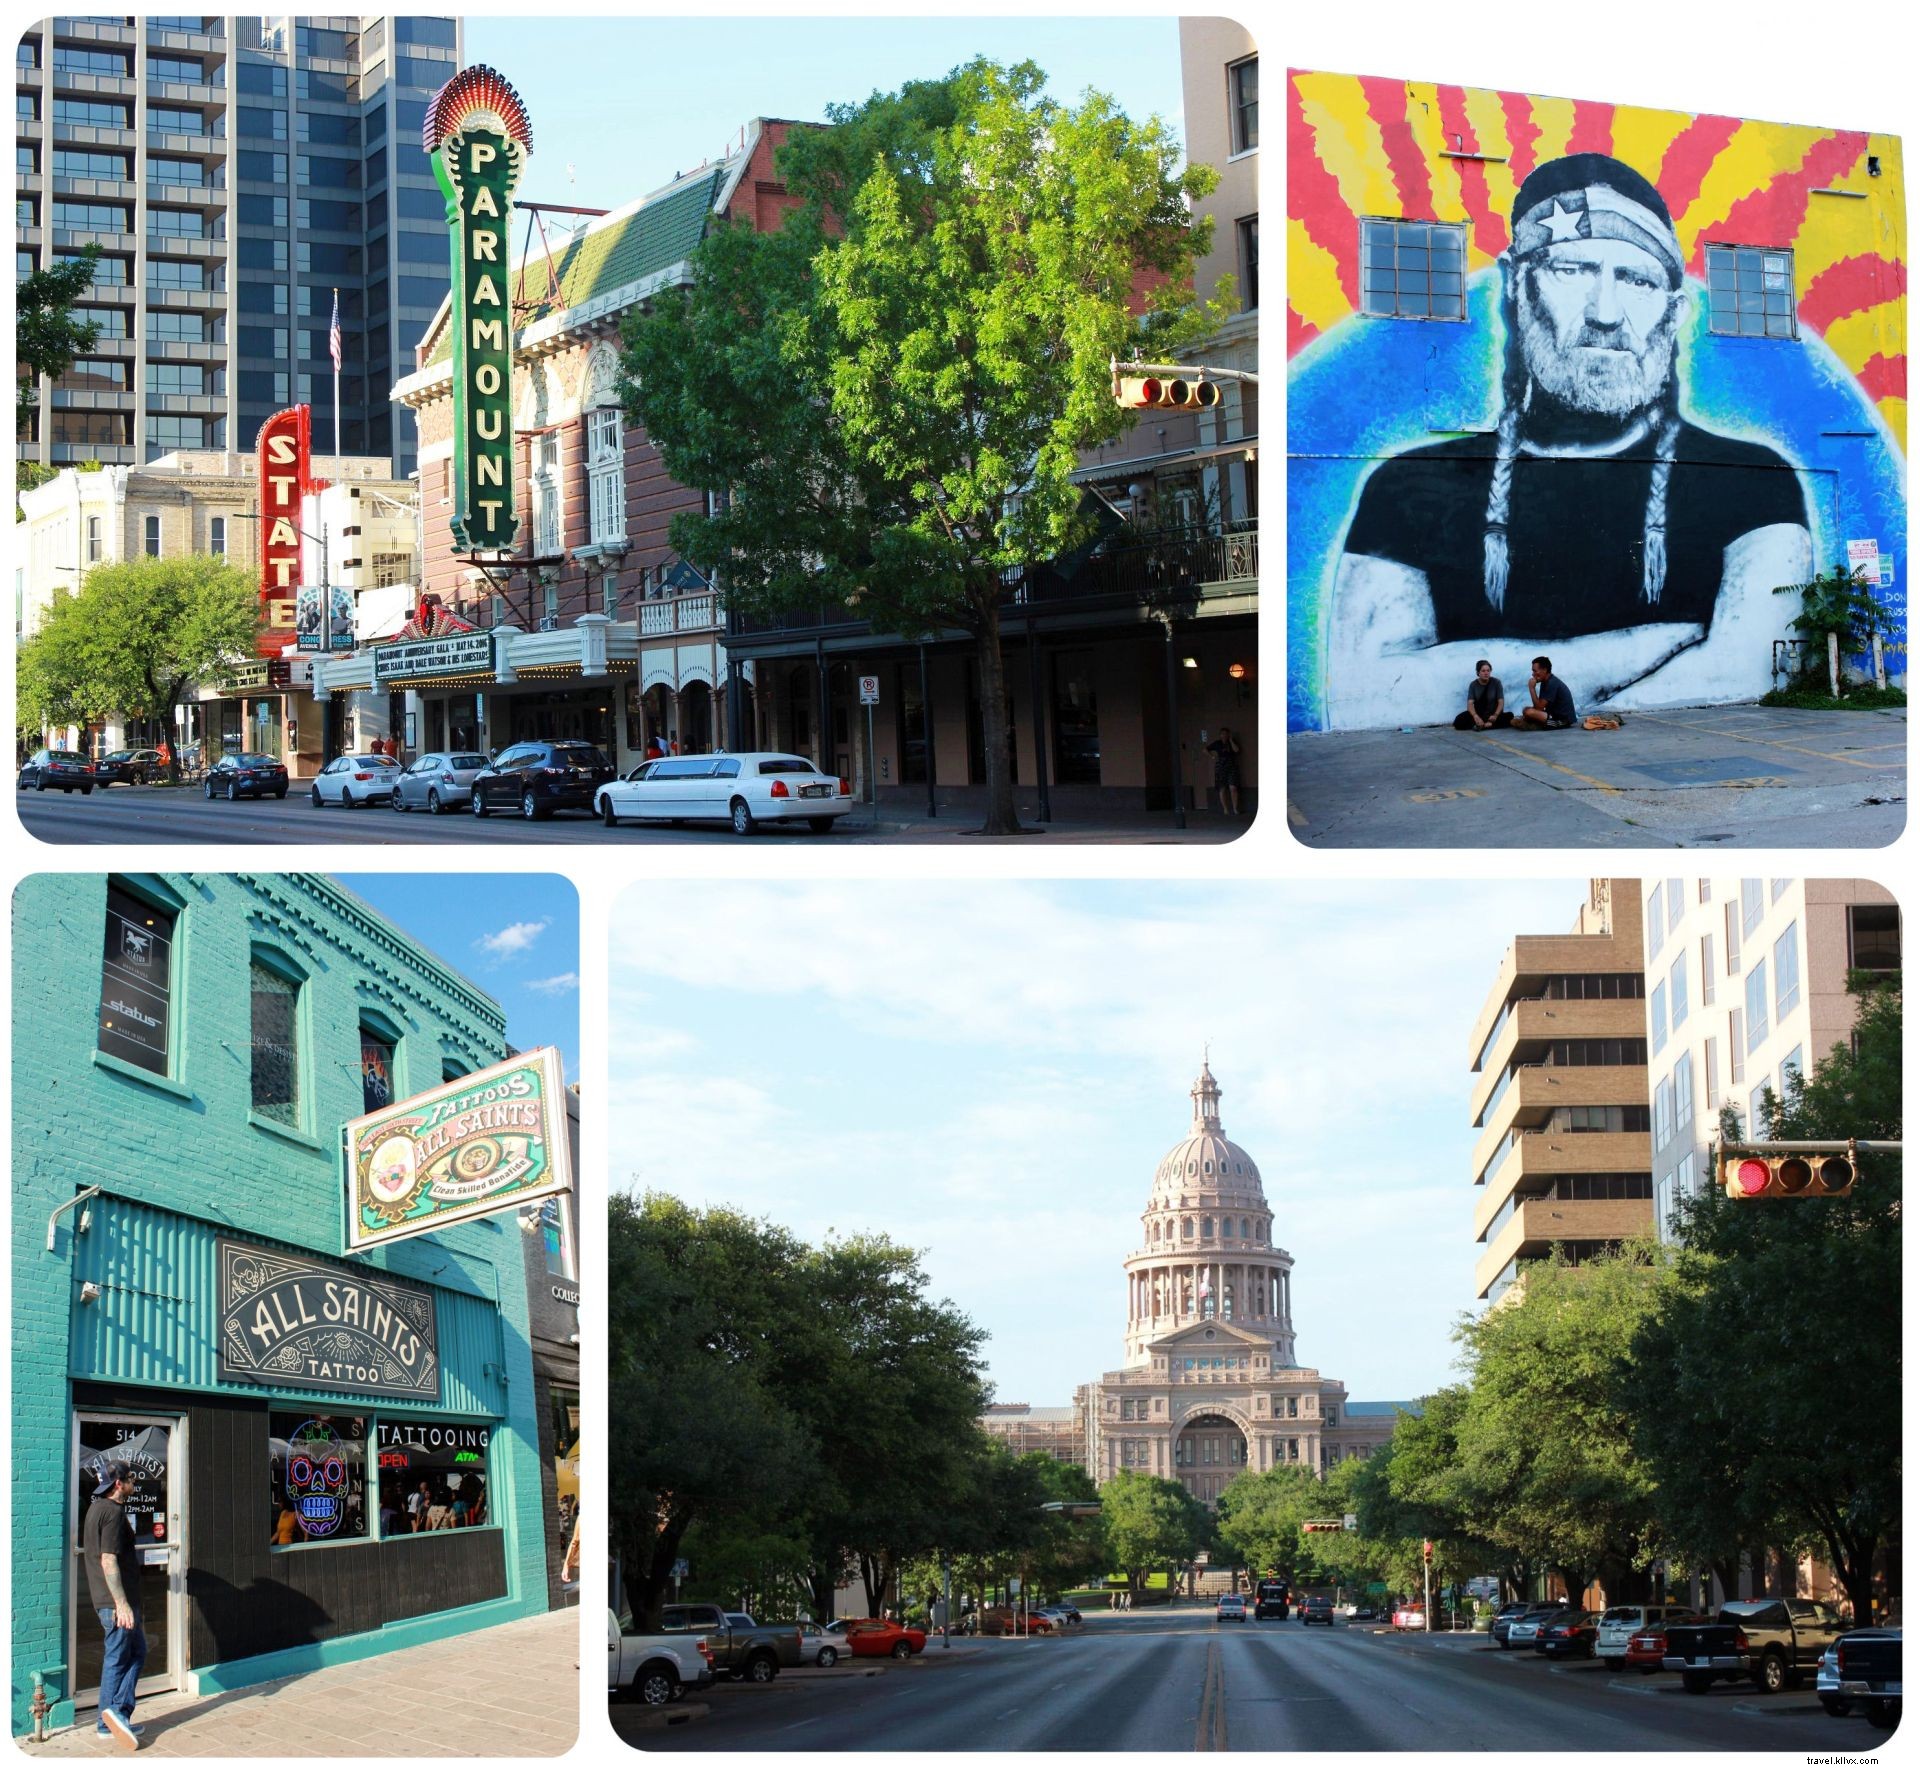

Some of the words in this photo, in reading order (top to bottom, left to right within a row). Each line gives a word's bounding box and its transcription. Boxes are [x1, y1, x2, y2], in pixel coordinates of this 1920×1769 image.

[470, 142, 503, 532] PARAMOUNT
[267, 435, 299, 629] STATE
[436, 643, 450, 654] GALA
[456, 641, 467, 651] MAY
[415, 658, 427, 668] DALE
[109, 1000, 157, 1027] status
[425, 1074, 533, 1129] TATTOOS
[416, 1127, 452, 1167] ALL
[455, 1103, 538, 1140] SAINTS
[432, 1185, 455, 1195] Clean
[456, 1181, 487, 1195] Skilled
[250, 1283, 317, 1348] ALL
[322, 1281, 420, 1366] SAINTS
[308, 1360, 379, 1382] TATTOO
[116, 1429, 135, 1441] 514
[378, 1425, 488, 1447] TATTOOING
[117, 1448, 159, 1472] SAINTS
[378, 1453, 408, 1468] OPEN
[454, 1452, 479, 1463] ATM
